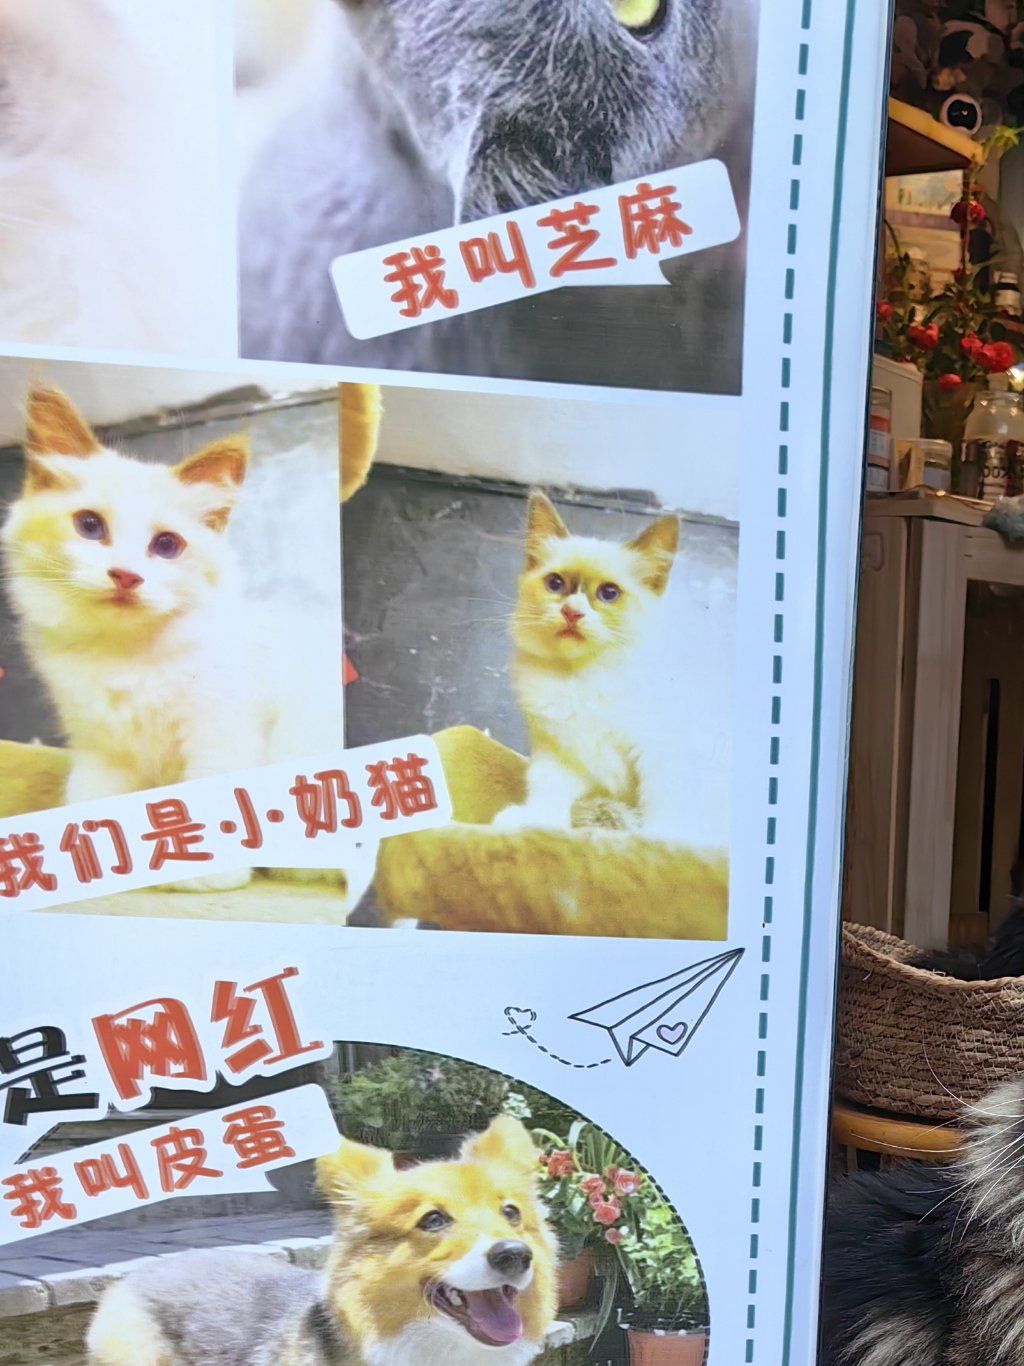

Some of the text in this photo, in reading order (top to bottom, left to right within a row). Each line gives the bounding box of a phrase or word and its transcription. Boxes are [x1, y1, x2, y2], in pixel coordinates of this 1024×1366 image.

[383, 183, 693, 318] 我叫芝麻
[0, 753, 438, 897] 我们是小奶猫
[0, 967, 325, 1126] 是网红
[2, 1105, 296, 1229] 我叫皮蛋
